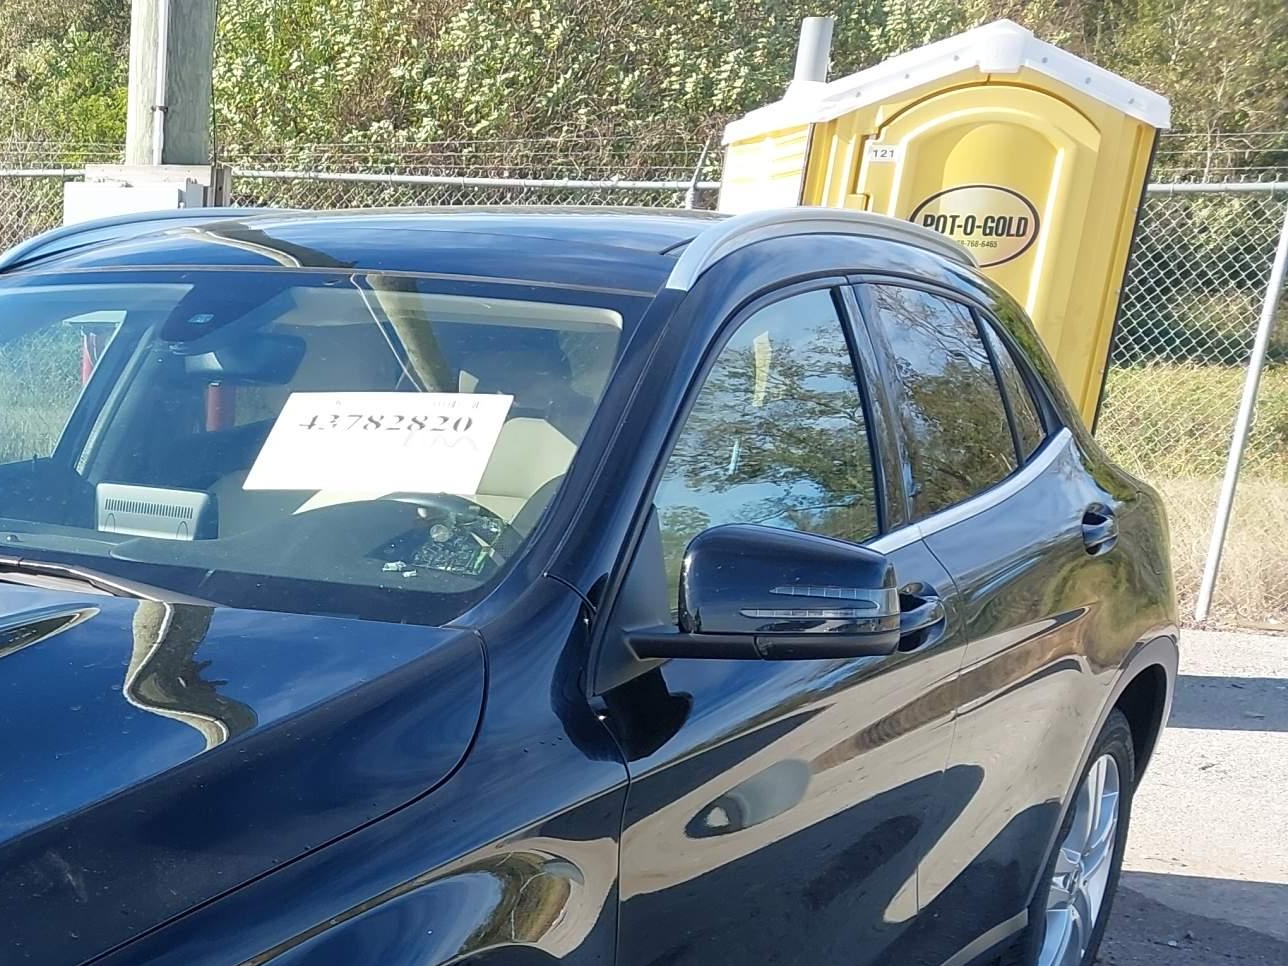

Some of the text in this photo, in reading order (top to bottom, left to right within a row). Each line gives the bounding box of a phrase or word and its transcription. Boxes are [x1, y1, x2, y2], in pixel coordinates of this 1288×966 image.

[872, 149, 895, 159] 121
[922, 213, 1029, 238] POT-O-GOLD
[298, 414, 474, 433] 43782820
